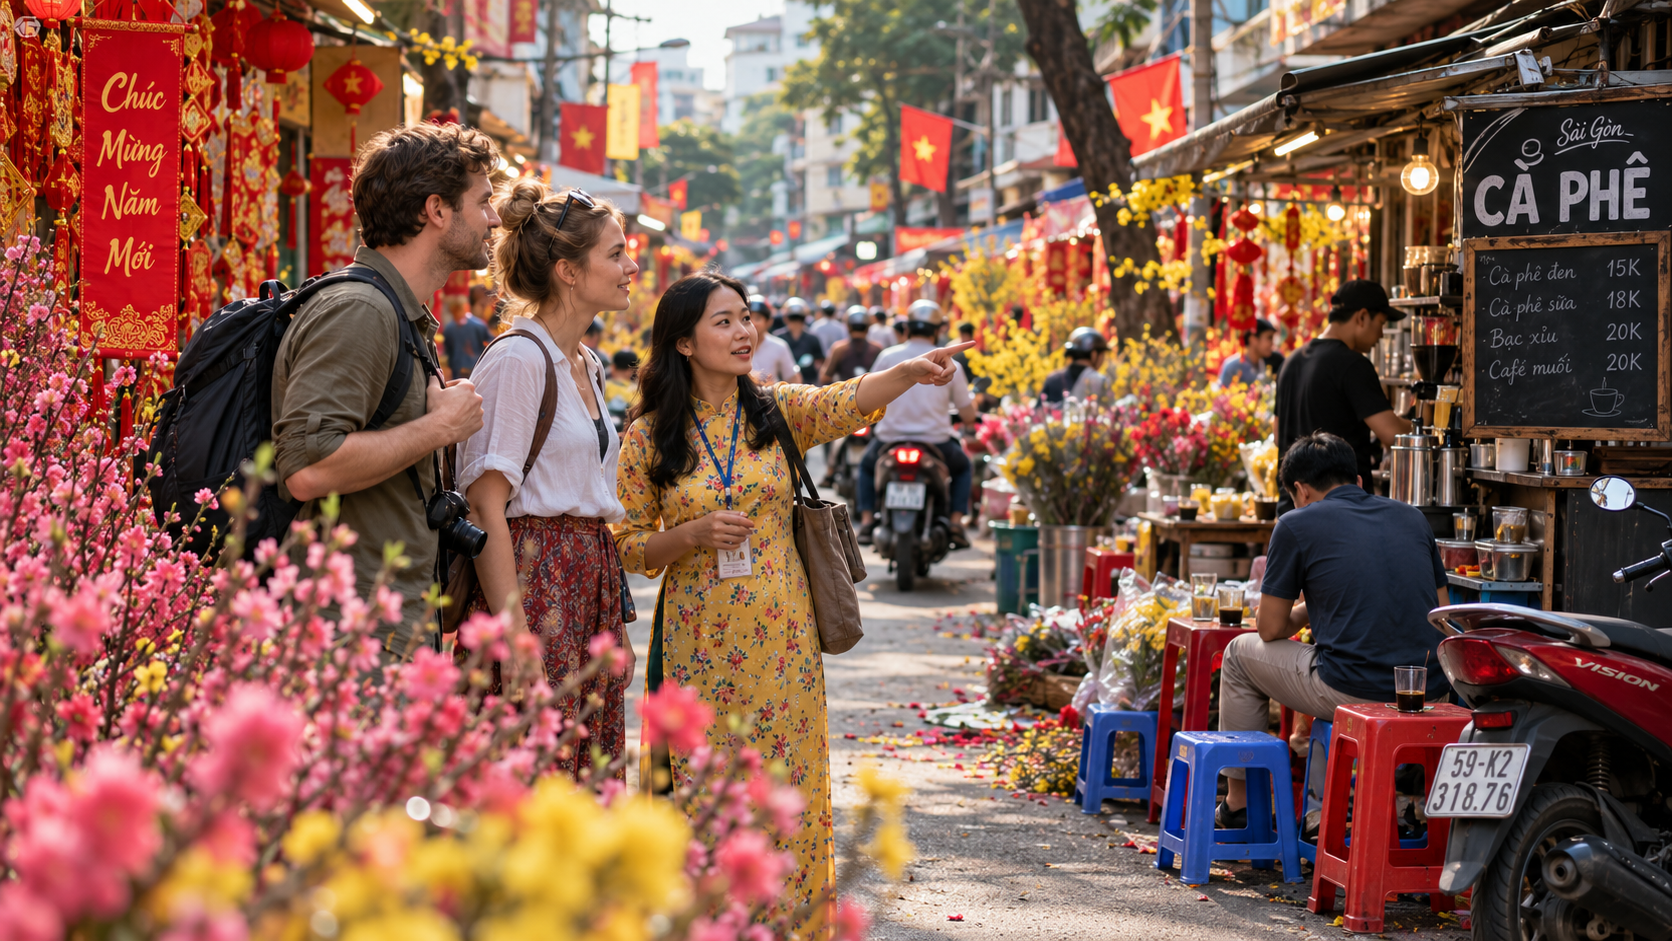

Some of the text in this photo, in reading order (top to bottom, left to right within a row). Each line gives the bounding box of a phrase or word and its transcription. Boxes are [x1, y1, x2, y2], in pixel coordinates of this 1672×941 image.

[101, 71, 167, 114] Chúc
[1556, 115, 1625, 149] Sài Gòn
[96, 128, 168, 178] Mừng
[101, 181, 162, 221] Năm
[1473, 151, 1651, 227] CÀ PHÊ
[104, 236, 156, 278] Mới
[1606, 258, 1641, 277] 15K
[1489, 261, 1577, 291] Cà phê đen
[1489, 294, 1577, 322] Cà phê sữa
[1606, 290, 1641, 309] 18K
[1489, 325, 1559, 351] Bạc xỉu
[1605, 322, 1642, 341] 20K
[1489, 353, 1573, 386] Café muối
[1606, 352, 1643, 371] 20K
[1573, 657, 1660, 692] VISION
[1451, 749, 1514, 779] 59-K2
[1432, 782, 1513, 812] 318.76
